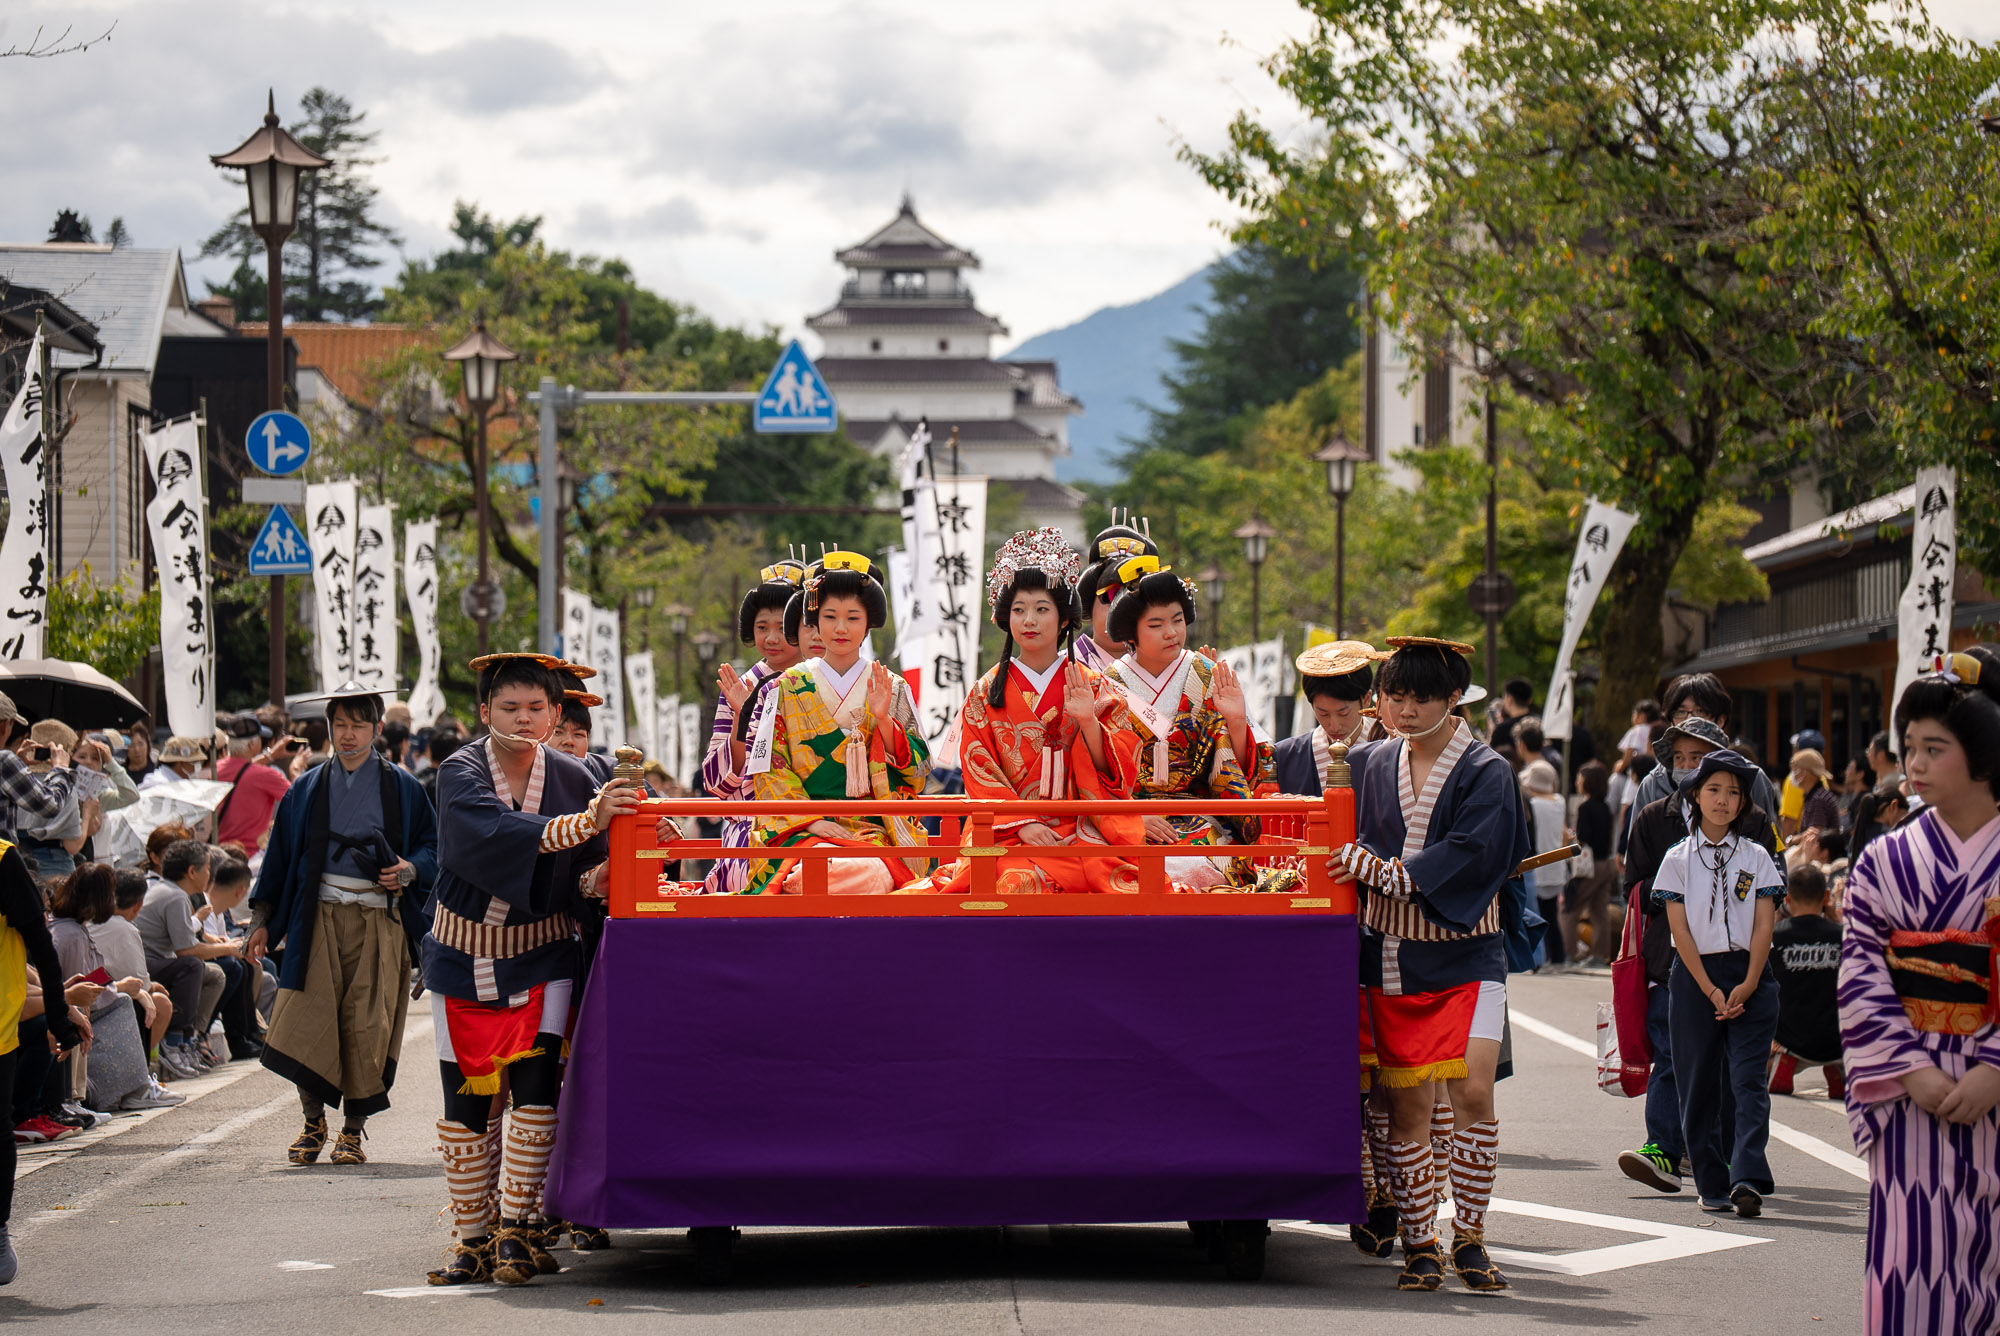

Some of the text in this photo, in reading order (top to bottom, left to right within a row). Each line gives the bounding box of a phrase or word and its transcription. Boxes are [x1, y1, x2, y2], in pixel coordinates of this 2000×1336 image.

[162, 499, 206, 709] 会津まつり
[356, 565, 385, 688] 会津まつ
